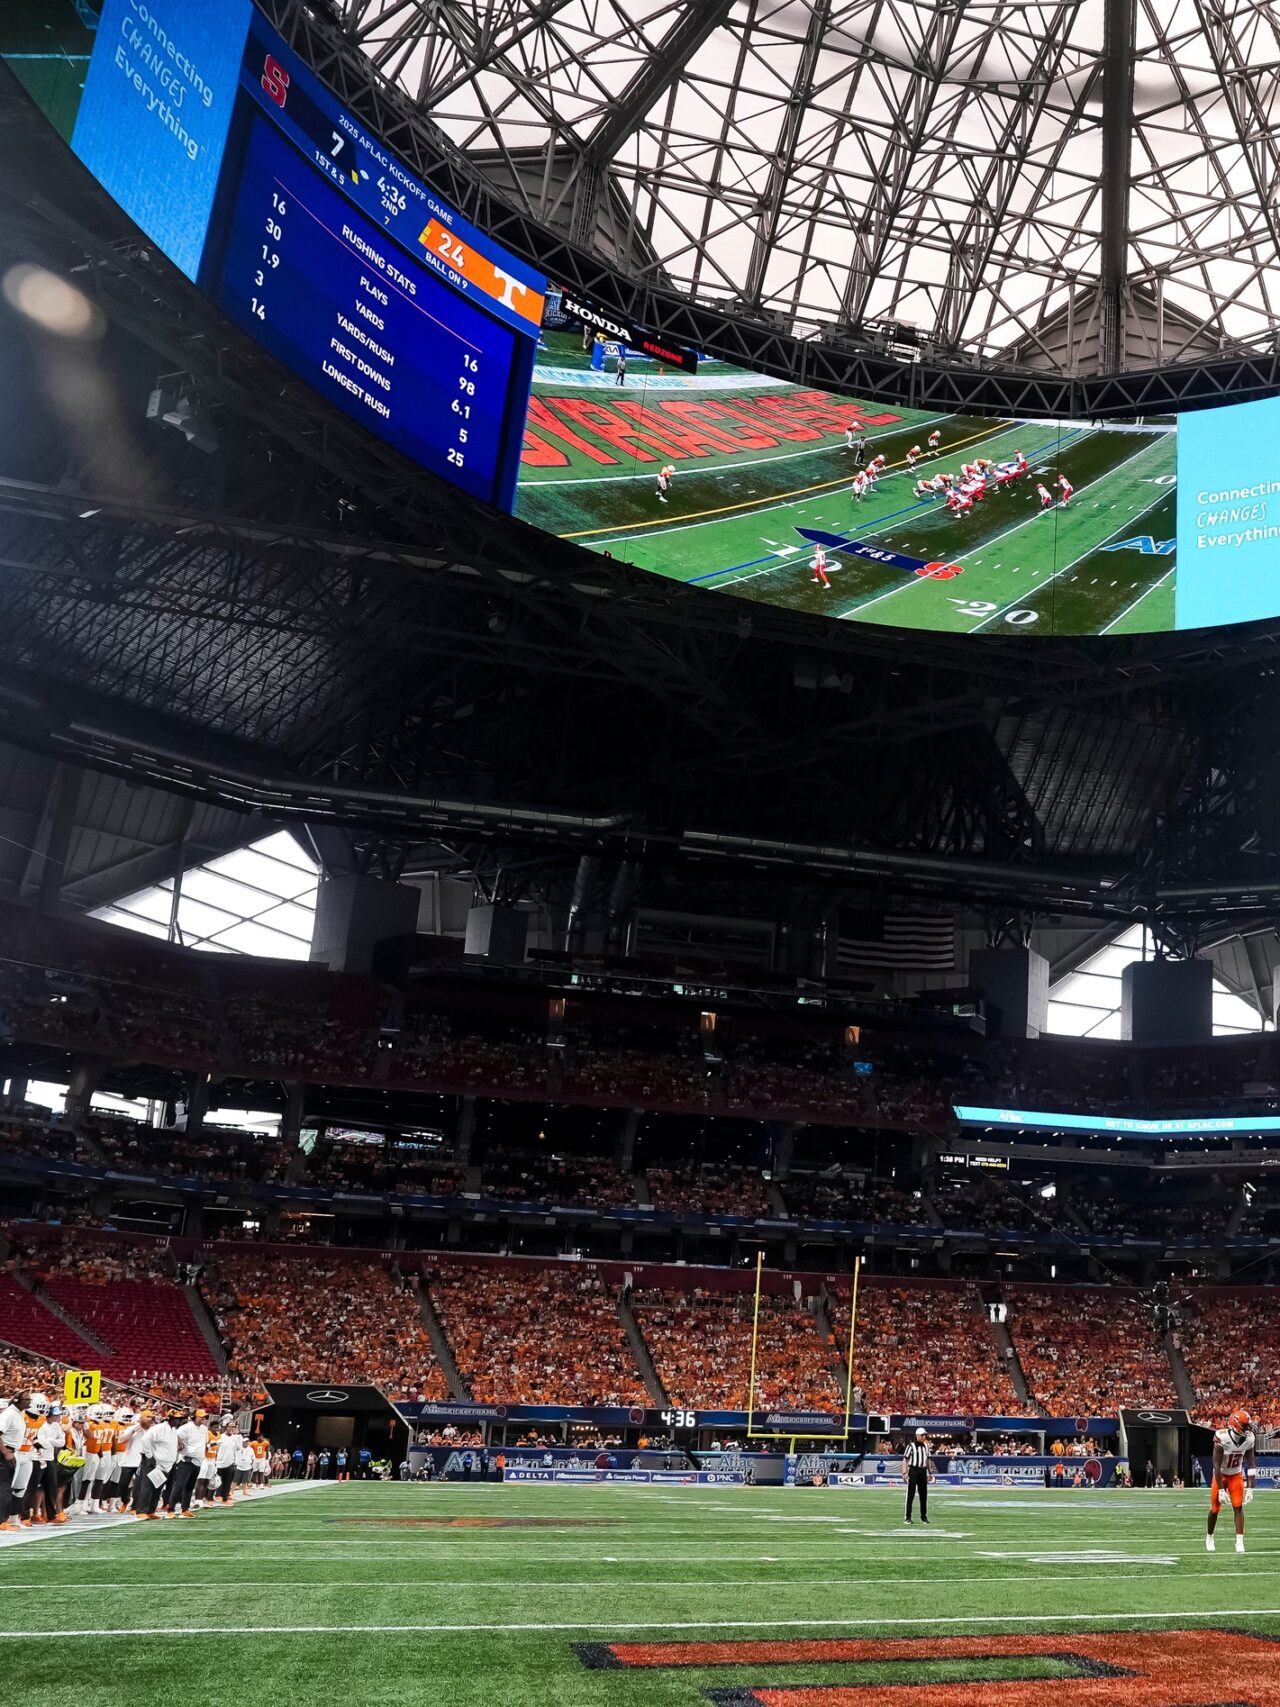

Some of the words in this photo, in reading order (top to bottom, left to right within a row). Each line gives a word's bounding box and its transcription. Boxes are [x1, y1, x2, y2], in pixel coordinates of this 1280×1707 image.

[121, 17, 187, 108] CHANGES
[115, 45, 199, 161] Everything
[331, 131, 345, 158] 7
[315, 150, 331, 169] 1ST
[338, 173, 345, 185] 5
[338, 114, 359, 139] 2025
[358, 136, 388, 168] AFLAC
[388, 163, 426, 202] KICKOFF
[427, 197, 453, 226] GAME
[272, 193, 286, 216] 16
[376, 176, 407, 211] 4:36
[380, 195, 399, 217] 2ND
[265, 218, 282, 242] 30
[262, 245, 280, 269] 1.9
[342, 224, 386, 270] RUSHING
[385, 264, 417, 296] STATS
[437, 233, 465, 268] 24
[254, 270, 264, 287] 3
[425, 251, 448, 278] BALL
[447, 268, 460, 283] ON
[461, 279, 468, 289] 9
[360, 275, 389, 306] PLAYS
[493, 266, 527, 312] T
[251, 297, 266, 321] 14
[355, 299, 385, 331] YARDS
[565, 299, 633, 342] HONDA
[336, 312, 395, 366] YARDS/RUSH
[330, 337, 358, 365] FIRST
[357, 358, 391, 392] DOWNS
[463, 354, 478, 373] 16
[643, 341, 683, 364] REDZONE
[322, 360, 365, 400] LONGEST
[364, 393, 391, 419] RUSH
[458, 376, 476, 396] 98
[451, 399, 471, 419] 6.1
[459, 428, 468, 443] 5
[447, 448, 465, 467] 25
[1196, 501, 1267, 529] CHANGES
[954, 1155, 965, 1164] PM
[74, 1376, 93, 1399] 13
[255, 1414, 264, 1434] T
[661, 1411, 696, 1428] 4:36
[1227, 1453, 1243, 1468] 12
[716, 1474, 734, 1482] PNC
